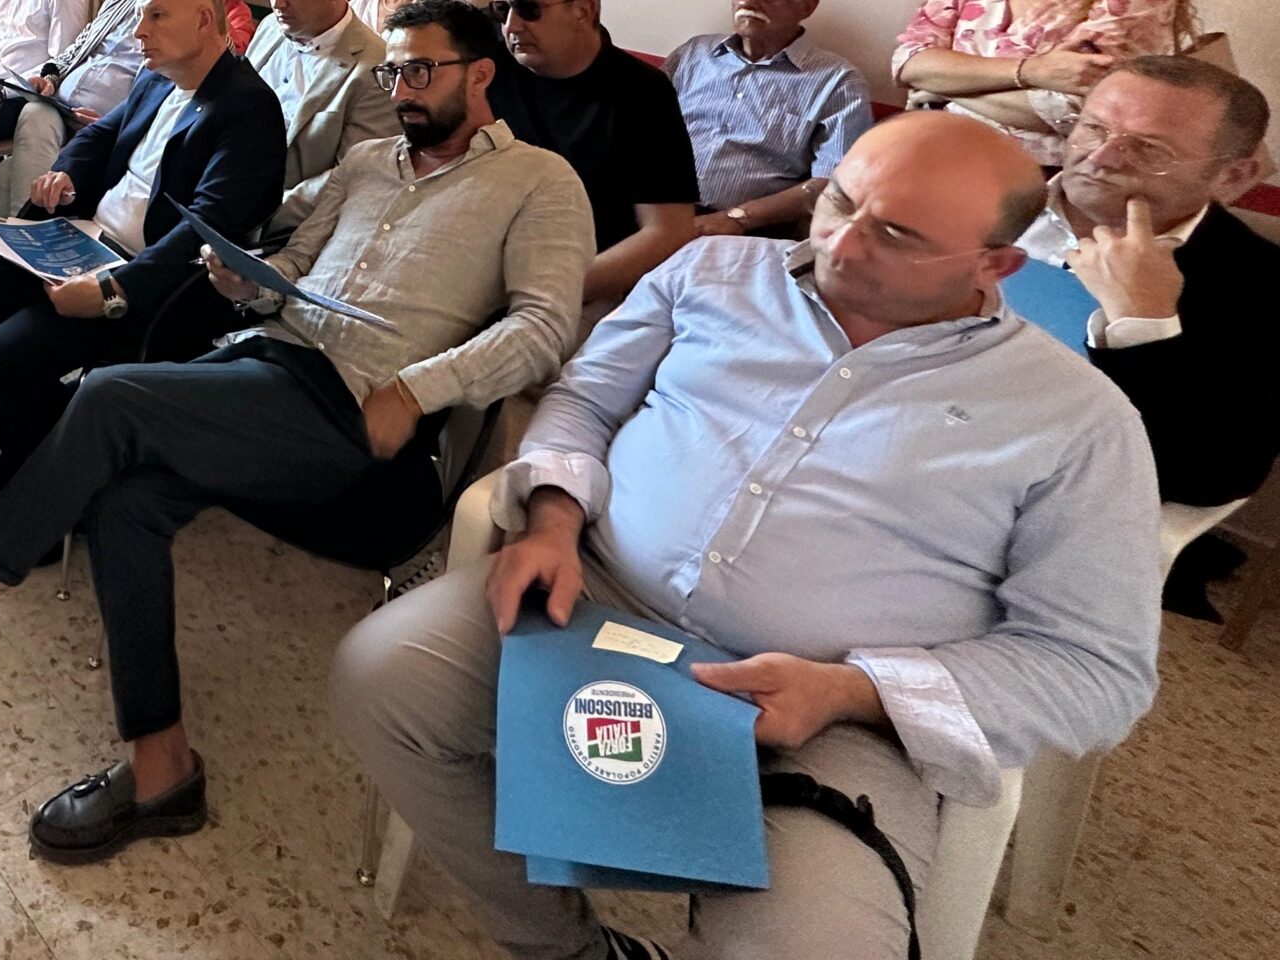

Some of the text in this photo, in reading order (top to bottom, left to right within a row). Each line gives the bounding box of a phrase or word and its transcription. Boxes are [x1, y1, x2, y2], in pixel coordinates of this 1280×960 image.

[574, 697, 653, 719] BERLUSCONI
[595, 721, 632, 739] ITALIA
[598, 737, 633, 757] FORZA
[643, 733, 662, 769] PARTITO
[594, 766, 642, 779] POPOLARE
